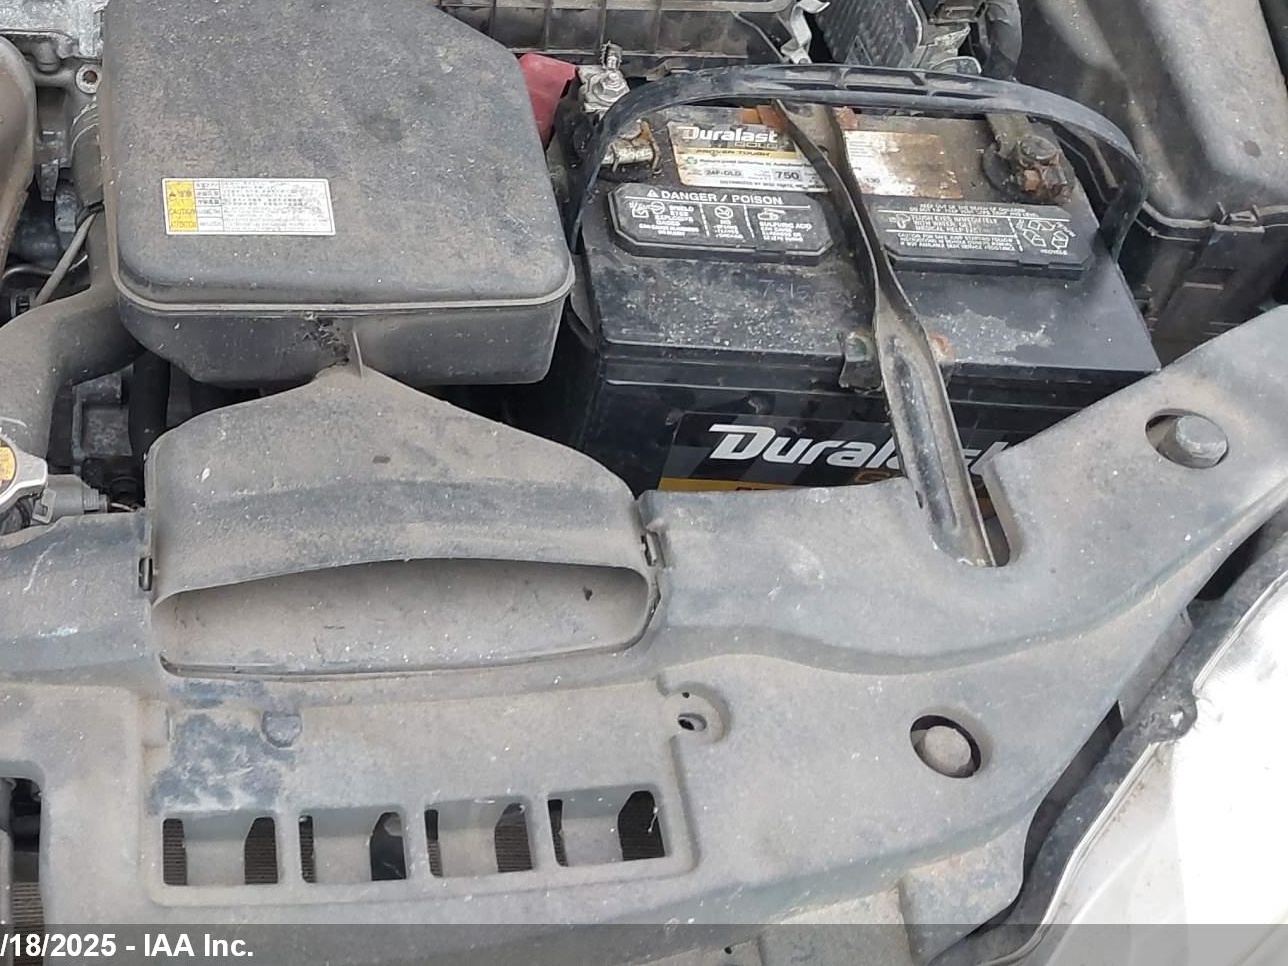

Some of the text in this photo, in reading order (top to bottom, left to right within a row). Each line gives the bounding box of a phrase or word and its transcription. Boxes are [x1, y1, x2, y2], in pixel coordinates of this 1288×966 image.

[678, 126, 778, 143] Duralast
[775, 171, 800, 180] 750
[661, 190, 784, 205] DANGER / POISON
[708, 422, 1009, 475] Duralt
